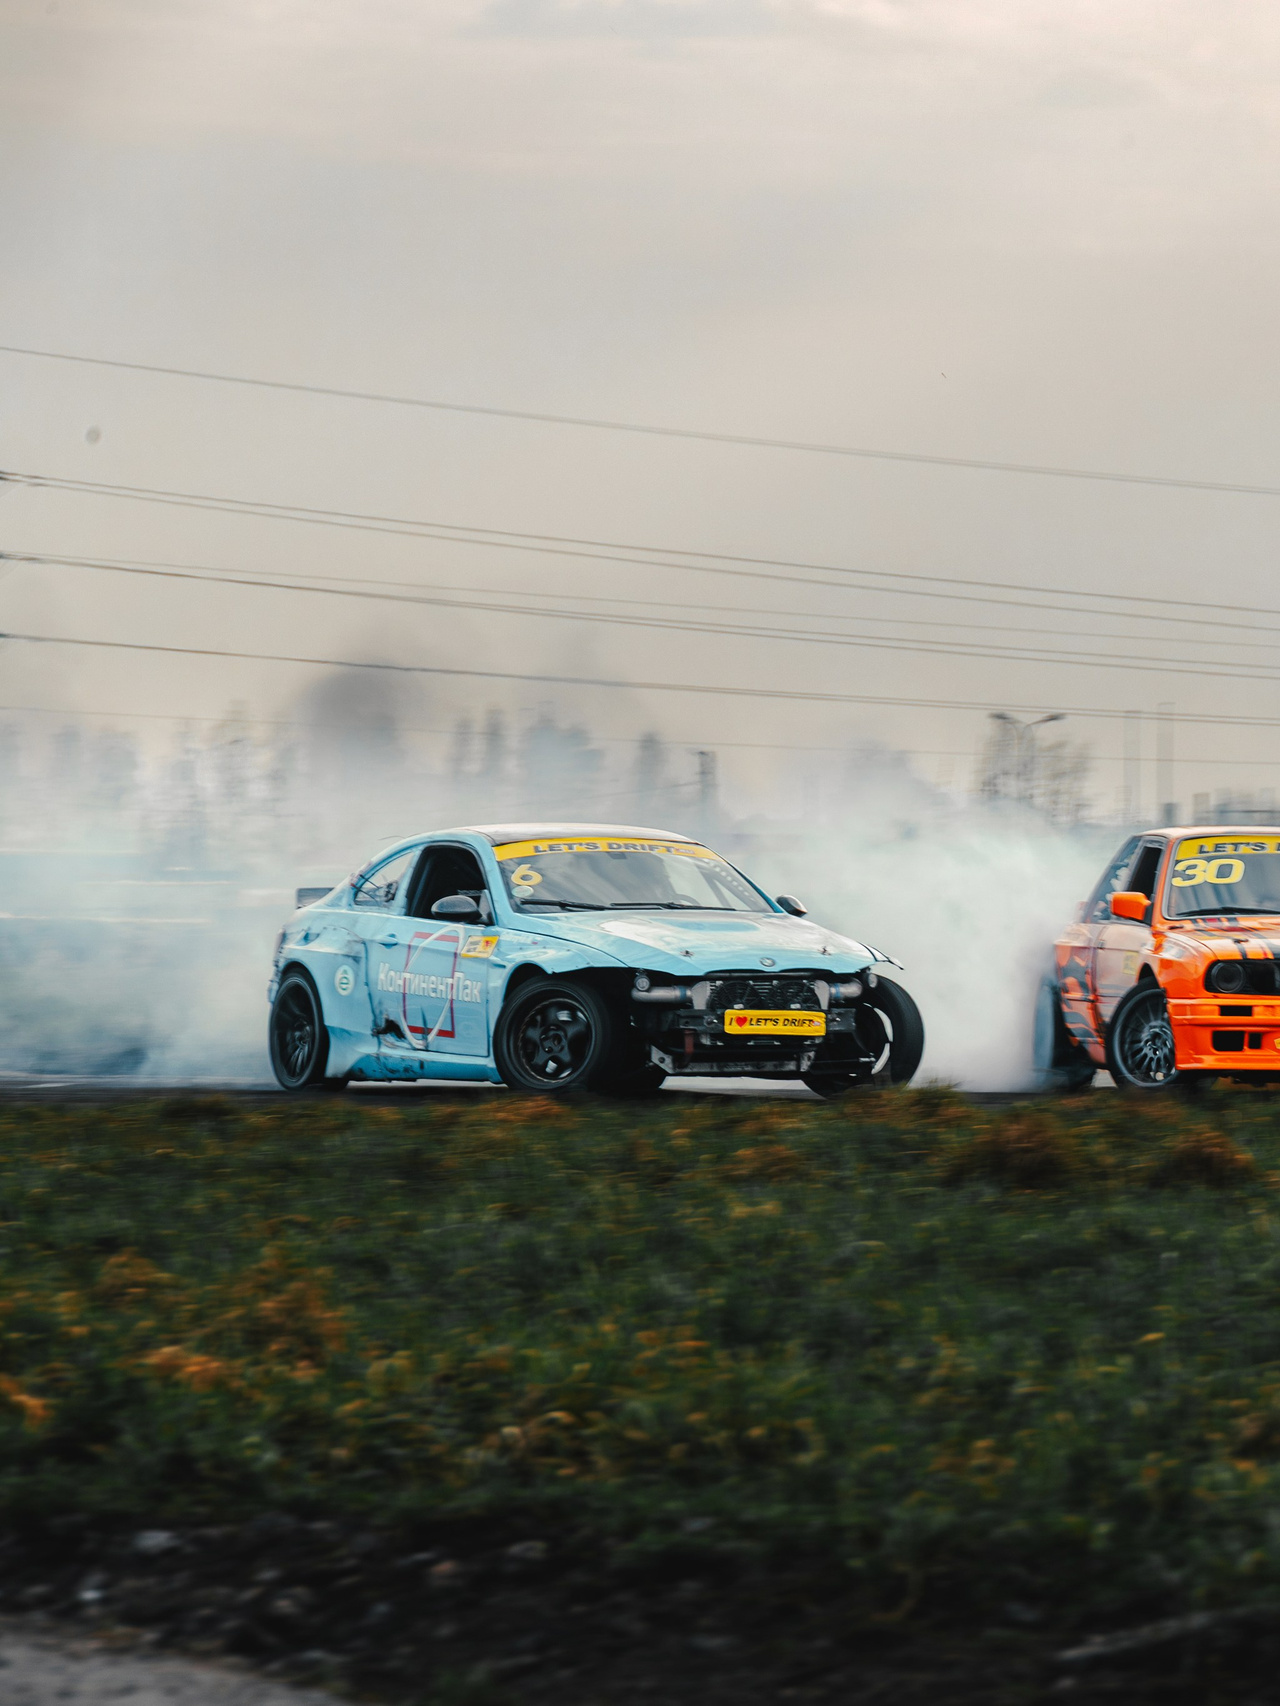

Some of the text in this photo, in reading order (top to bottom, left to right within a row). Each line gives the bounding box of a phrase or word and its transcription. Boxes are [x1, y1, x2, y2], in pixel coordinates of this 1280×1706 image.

[533, 842, 600, 854] LET'S
[607, 842, 676, 854] DRIFT
[1198, 842, 1267, 855] LET'S
[510, 864, 543, 886] 6
[1171, 858, 1246, 888] 30
[377, 962, 483, 1004] КонтинентПак
[729, 1017, 733, 1026] I
[748, 1017, 780, 1027] LET'S
[782, 1018, 813, 1027] DRIFT
